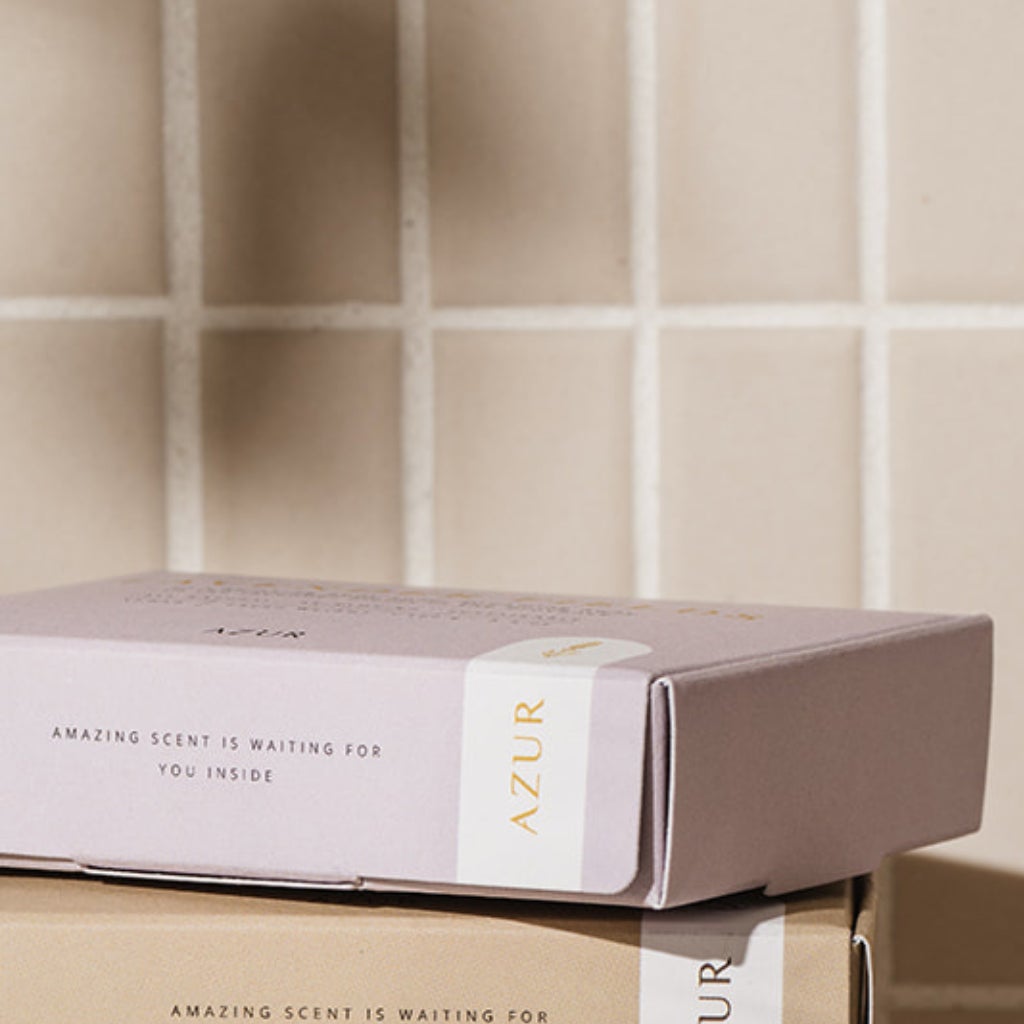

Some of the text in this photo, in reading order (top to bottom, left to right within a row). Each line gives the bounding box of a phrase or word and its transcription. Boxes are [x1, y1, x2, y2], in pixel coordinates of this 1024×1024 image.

[51, 726, 381, 759] AMAZING SCENT IS WAITING FOR
[158, 763, 273, 784] YOU INSIDE
[509, 698, 546, 836] AZUR
[170, 1004, 548, 1024] AMAZING SCENT IS WAITING FOR
